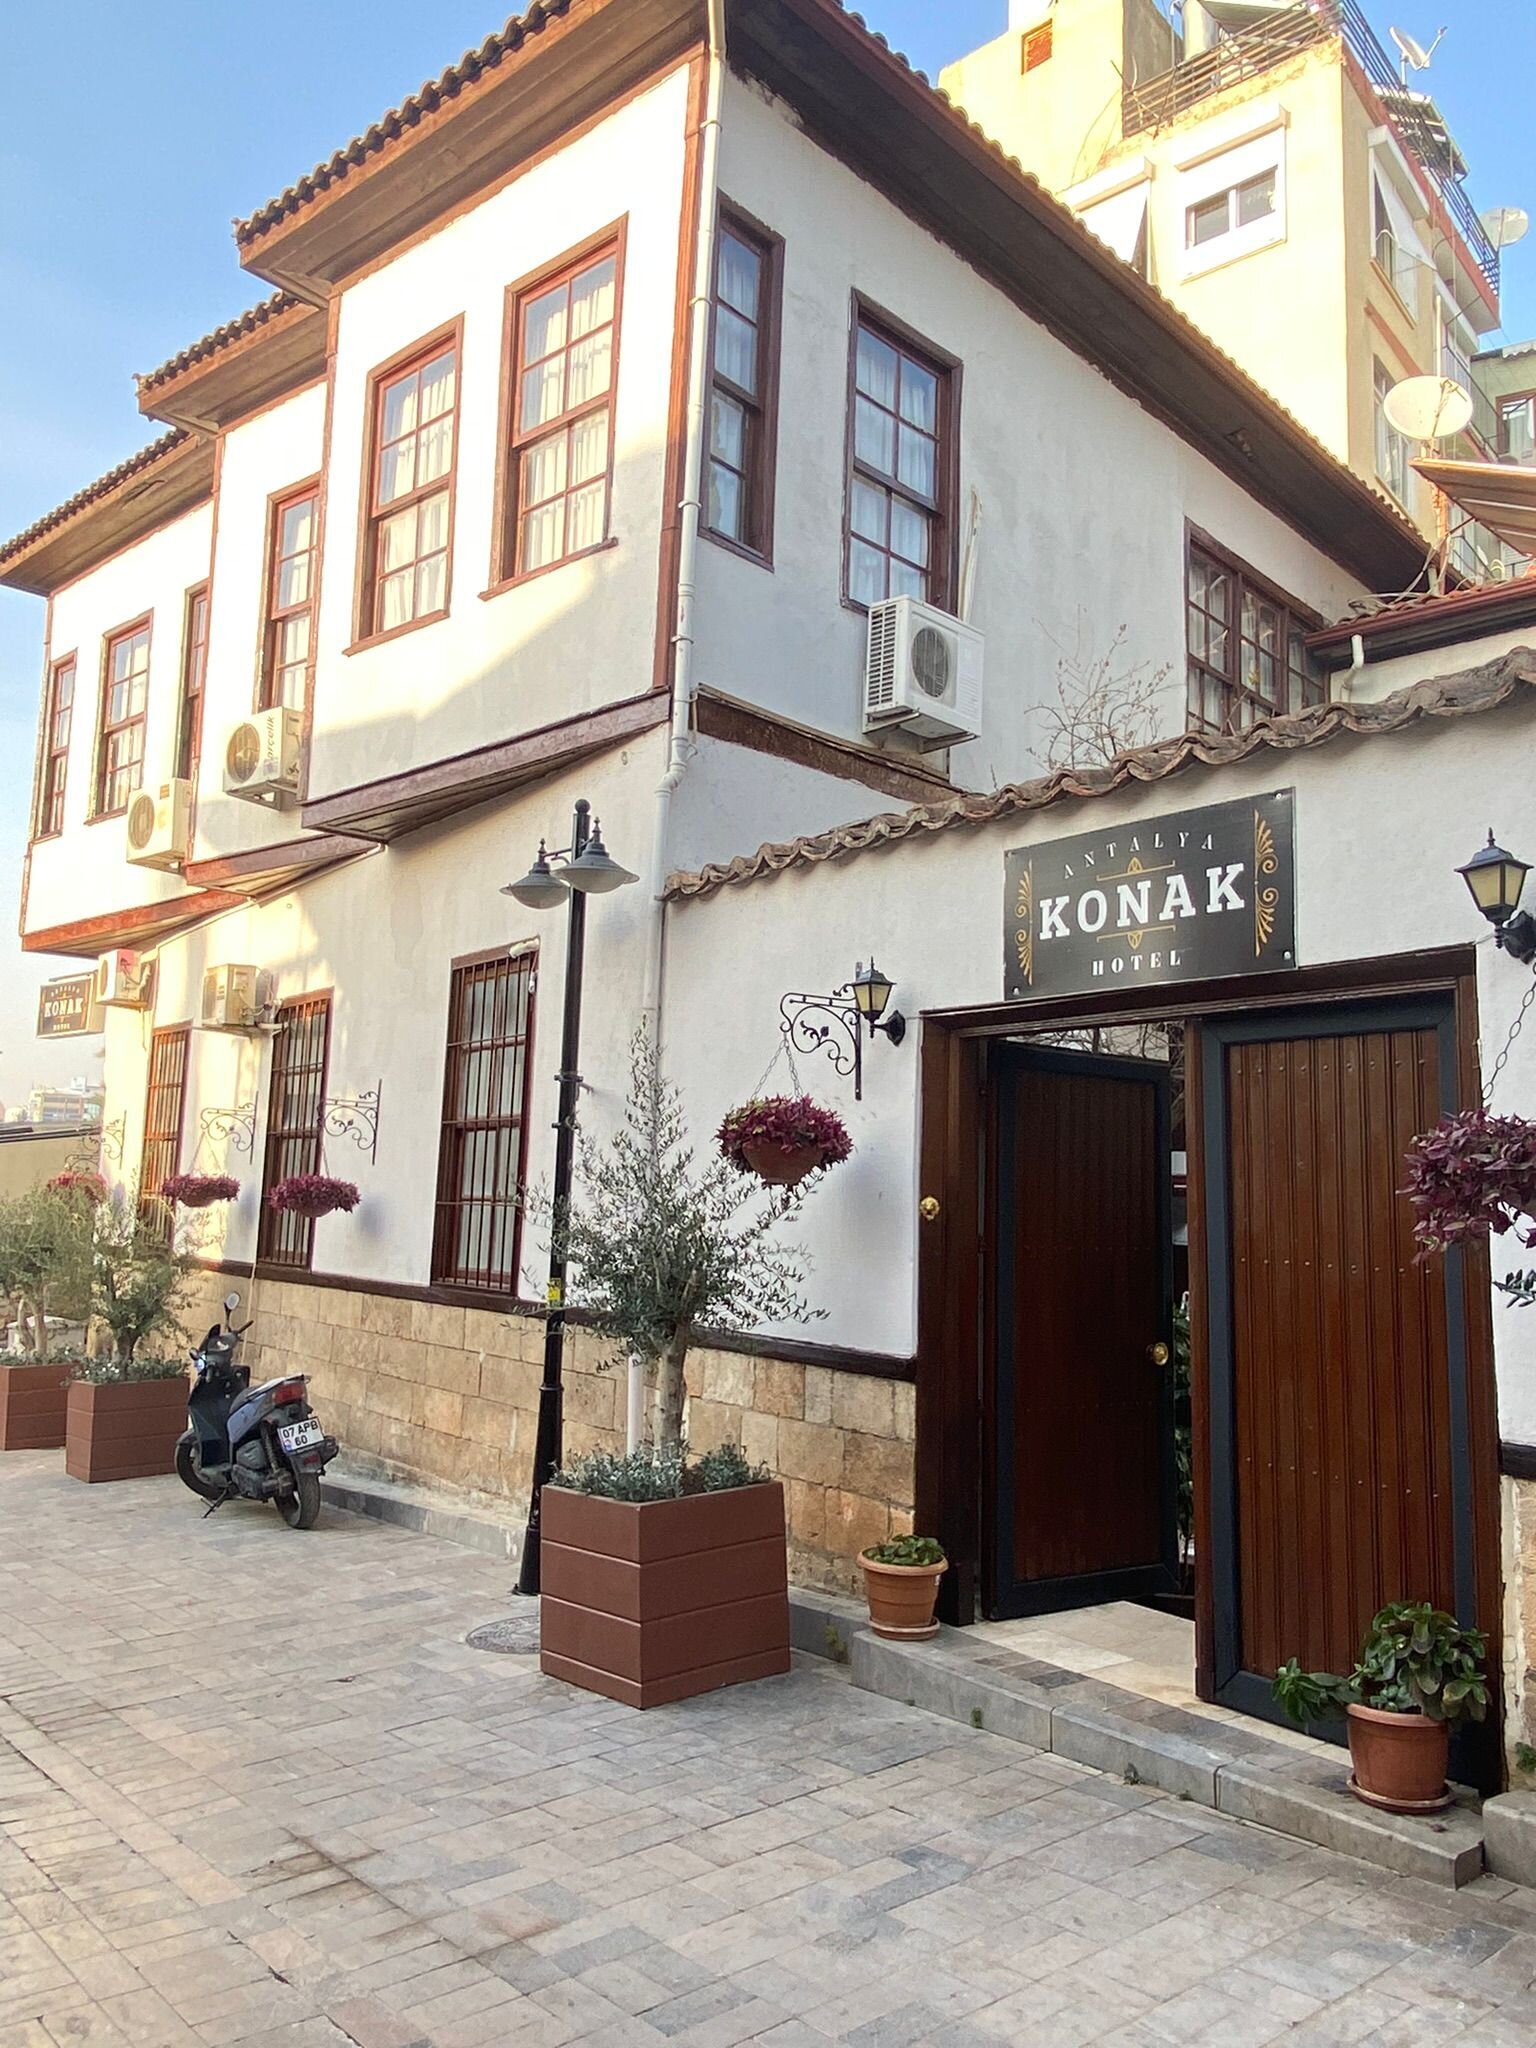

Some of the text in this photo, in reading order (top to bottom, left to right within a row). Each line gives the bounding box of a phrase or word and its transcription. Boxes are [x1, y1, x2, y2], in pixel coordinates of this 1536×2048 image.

[1064, 832, 1213, 879] ANTALYA
[1039, 863, 1245, 940] KONAK
[1092, 950, 1181, 976] HOTEL
[44, 998, 83, 1018] KONAK
[283, 1420, 318, 1438] 07 APB
[294, 1435, 308, 1446] 60
